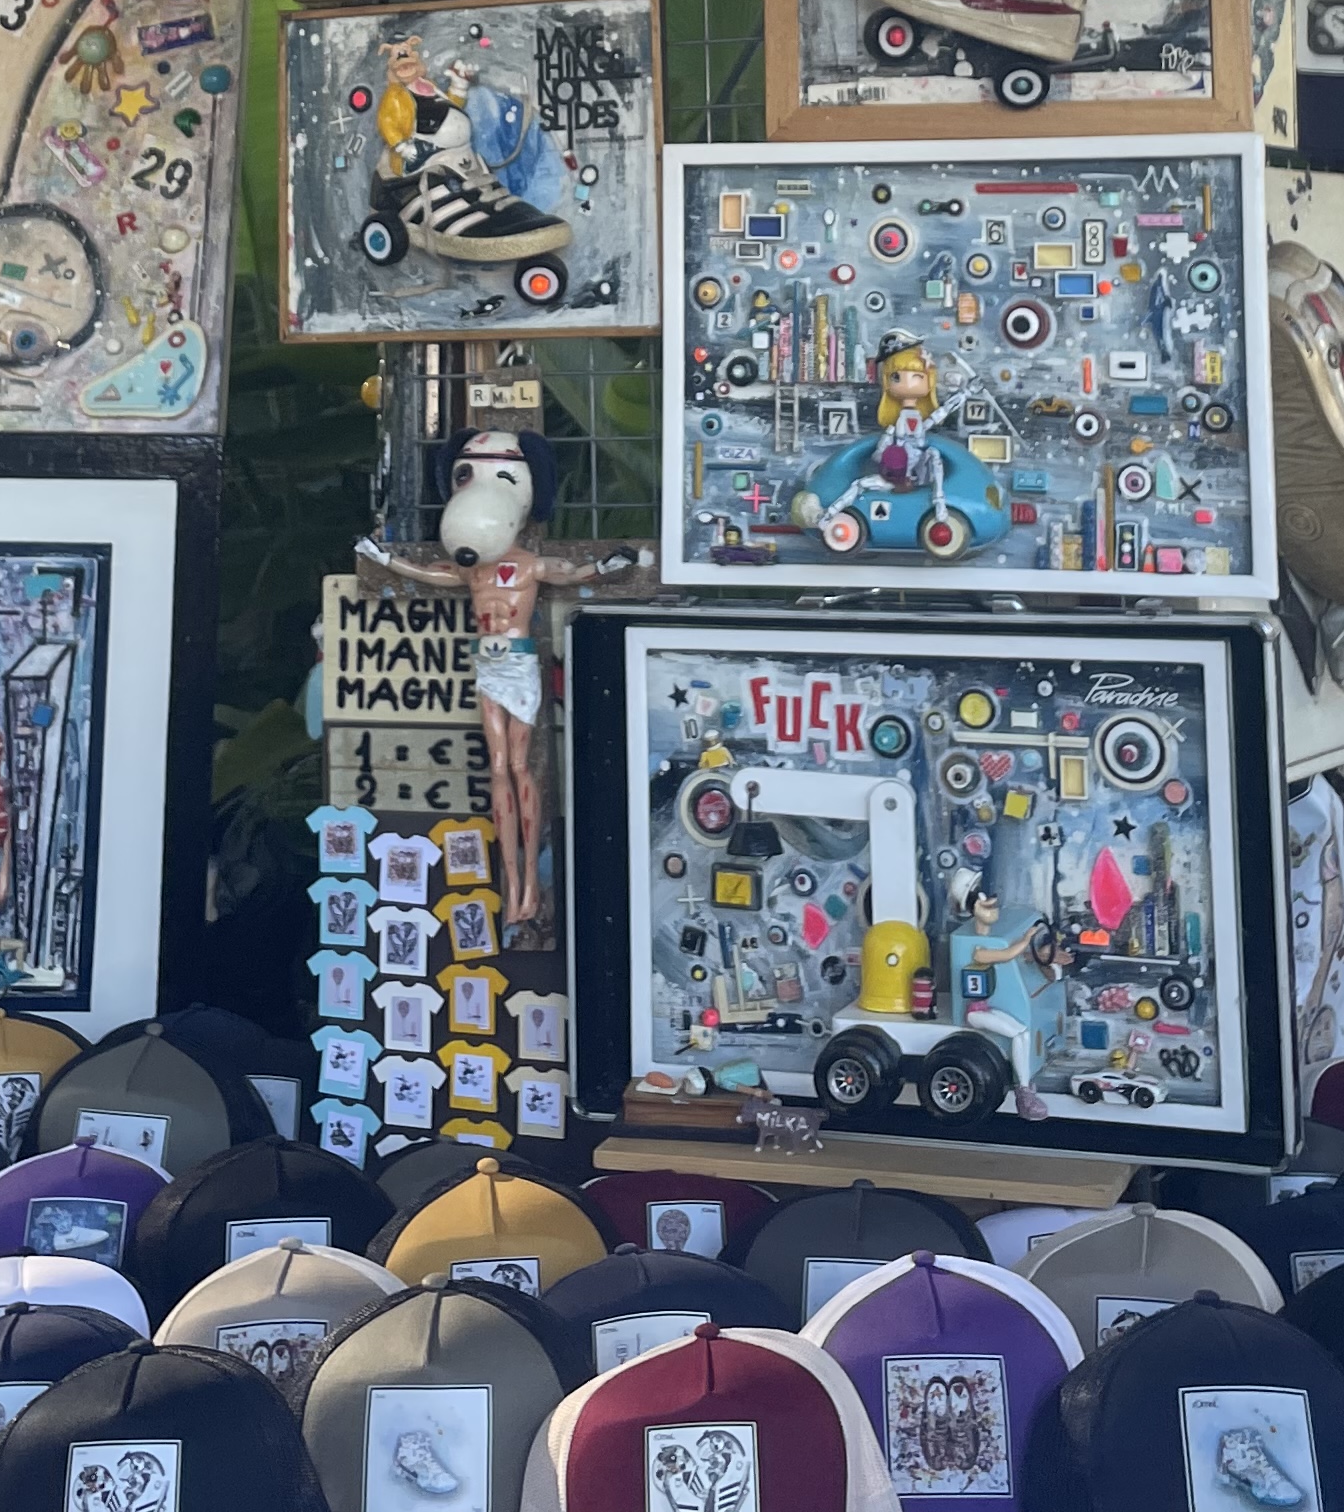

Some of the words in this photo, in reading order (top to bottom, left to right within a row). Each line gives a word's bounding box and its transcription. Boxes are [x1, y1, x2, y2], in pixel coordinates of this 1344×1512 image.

[534, 50, 628, 81] THING
[132, 147, 193, 199] 29
[833, 413, 845, 433] 7
[969, 403, 985, 418] 17
[1084, 673, 1179, 707] Paradise
[750, 677, 864, 752] FUCK
[355, 774, 377, 807] 2
